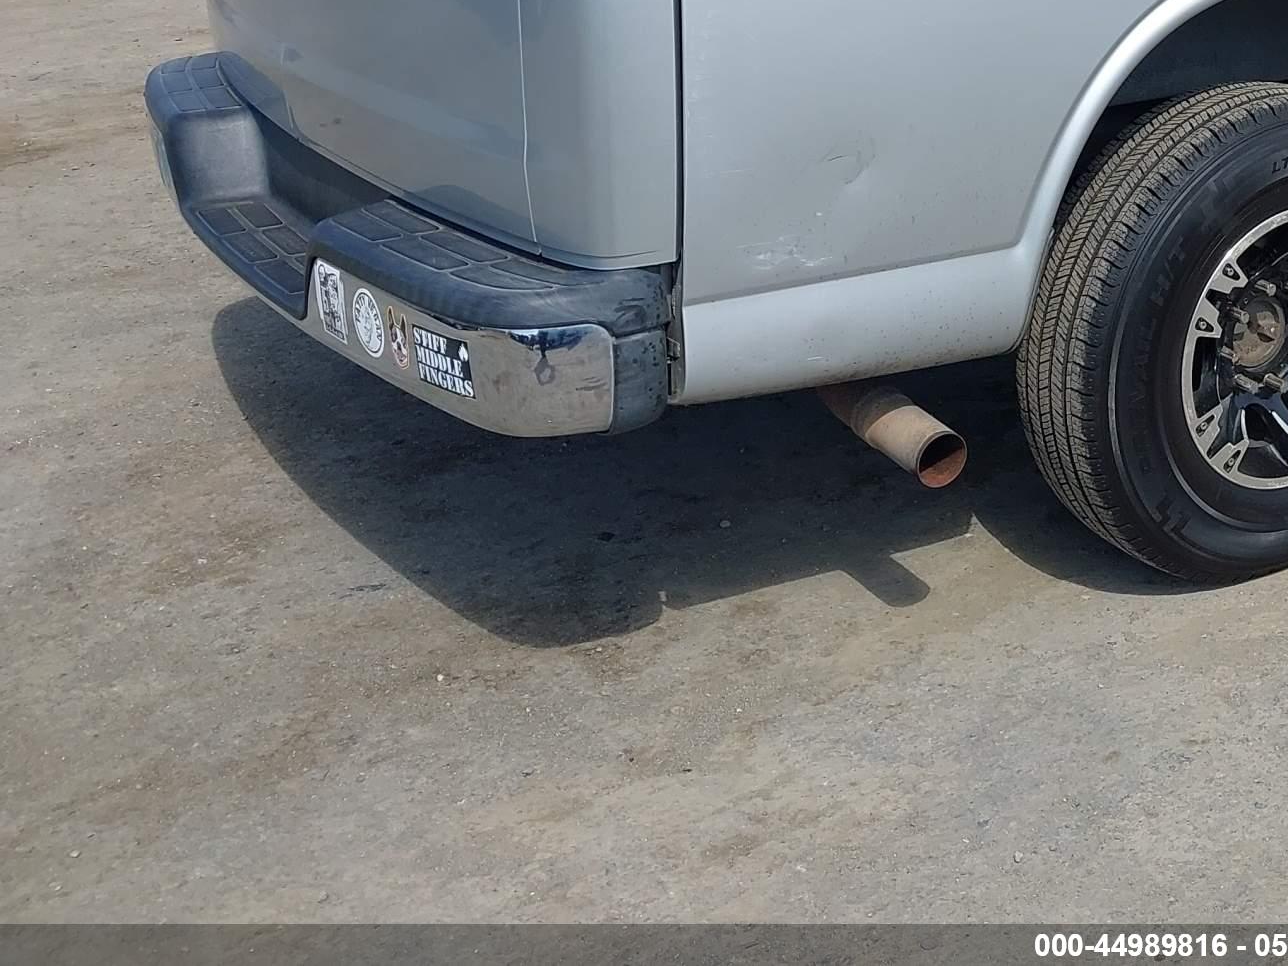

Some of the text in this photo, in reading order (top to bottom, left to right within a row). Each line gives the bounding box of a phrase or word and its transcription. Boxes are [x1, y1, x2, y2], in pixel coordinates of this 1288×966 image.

[413, 326, 447, 354] STIFF
[415, 344, 464, 378] MIDDLE
[418, 362, 475, 398] FINGERS
